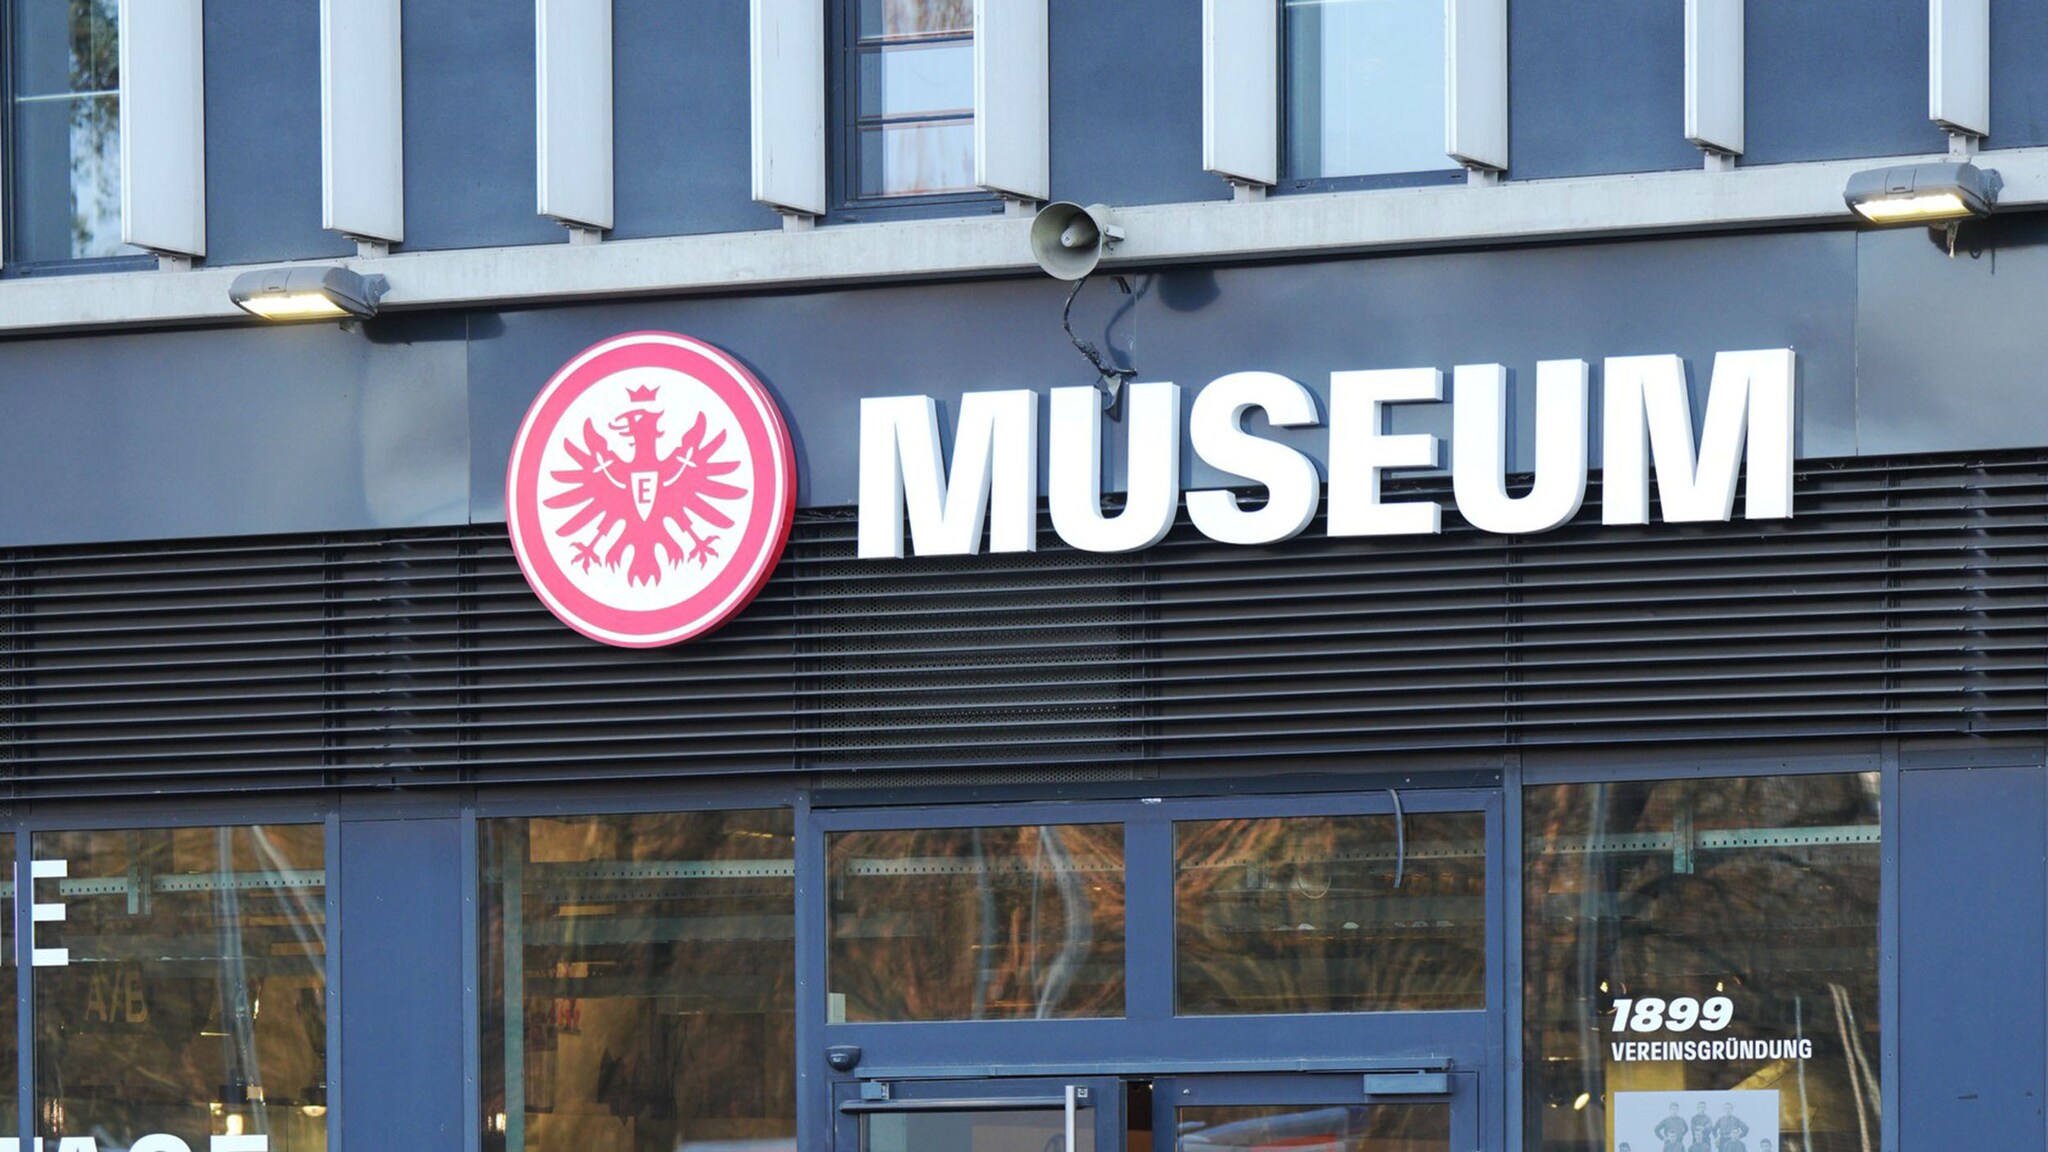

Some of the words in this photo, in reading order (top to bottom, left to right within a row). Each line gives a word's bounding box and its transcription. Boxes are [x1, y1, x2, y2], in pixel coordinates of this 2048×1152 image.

[857, 346, 1796, 560] MUSEUM
[637, 478, 651, 504] E
[1612, 997, 1734, 1032] 1899
[1611, 1038, 1812, 1061] VEREINSGRÜNDUNG
